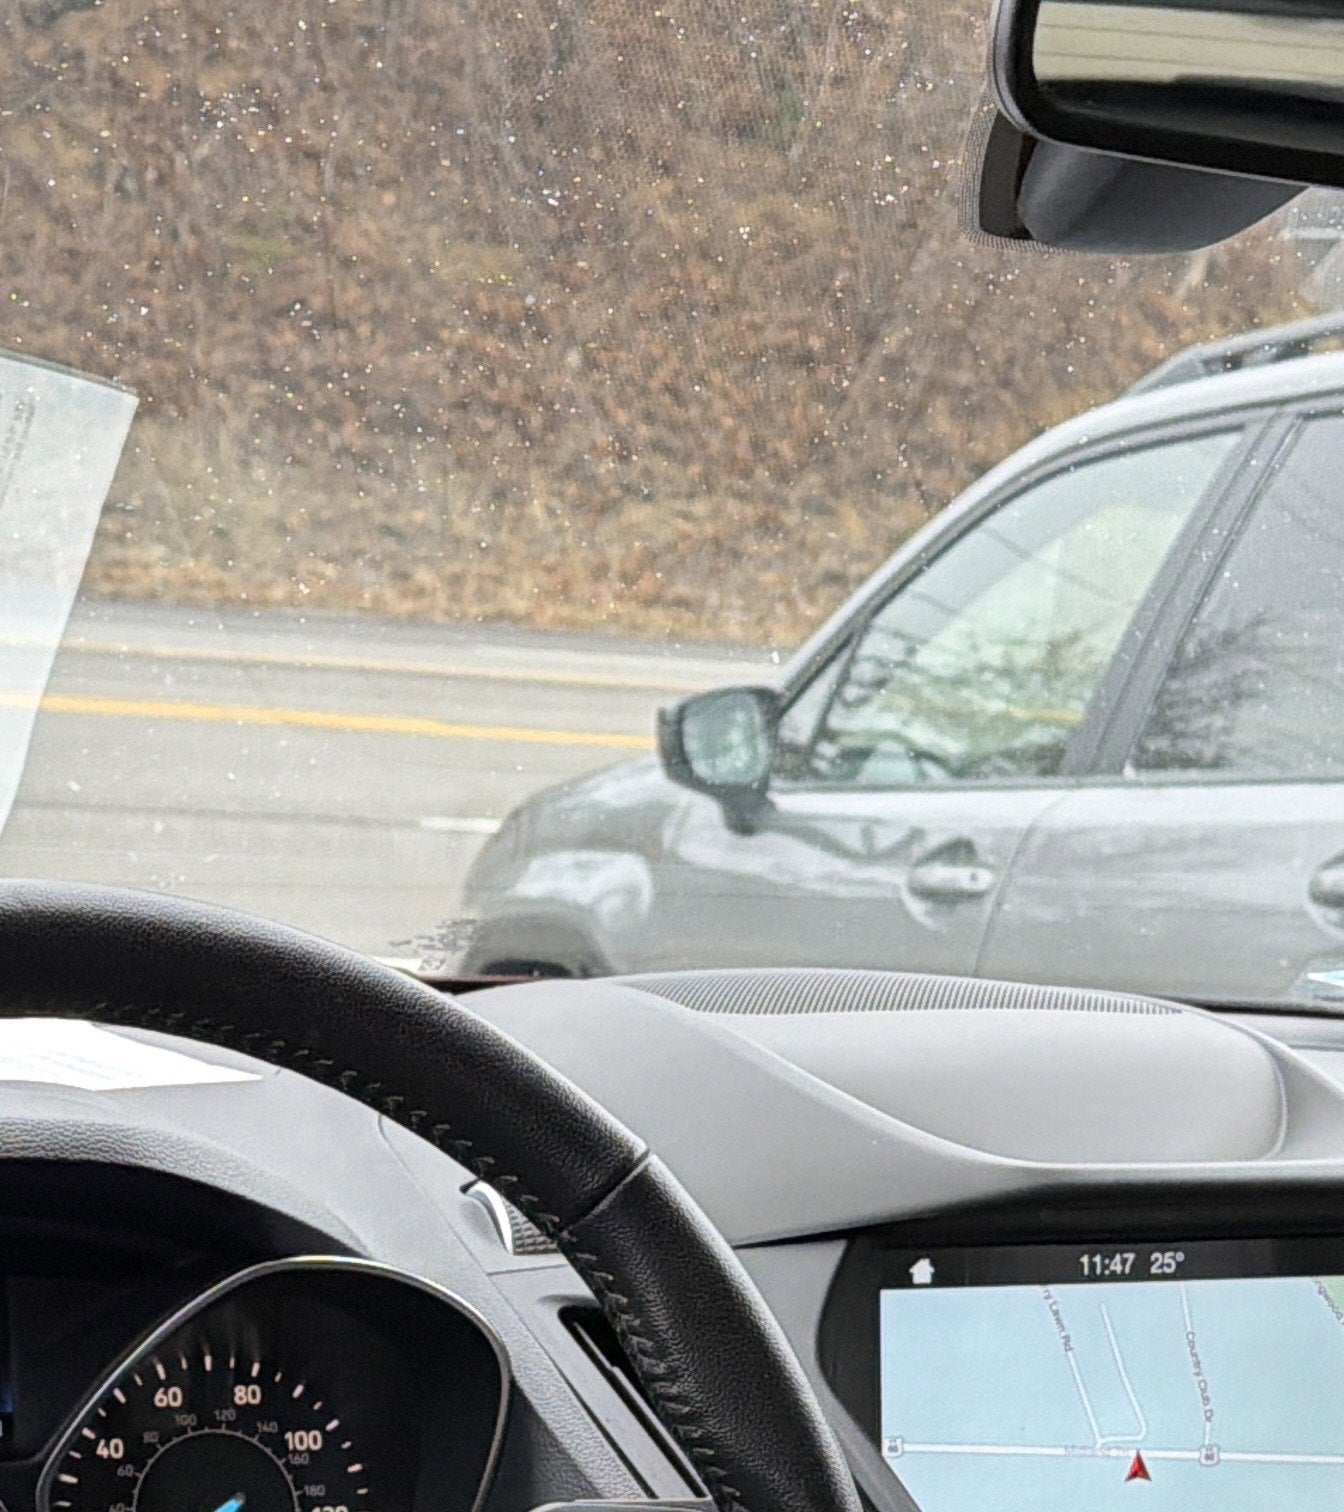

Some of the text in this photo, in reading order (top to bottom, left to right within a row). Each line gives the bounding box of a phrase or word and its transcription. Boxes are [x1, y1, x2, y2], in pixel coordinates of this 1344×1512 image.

[1079, 1251, 1186, 1276] 11:47 25°
[1186, 1331, 1202, 1378] Country
[1198, 1379, 1211, 1407] Club
[154, 1386, 183, 1407] 60
[233, 1384, 262, 1406] 80
[214, 1408, 236, 1422] 120
[95, 1438, 124, 1459] 40
[284, 1429, 323, 1451] 100
[287, 1452, 310, 1466] 160
[116, 1463, 134, 1478] 60
[303, 1484, 326, 1498] 180
